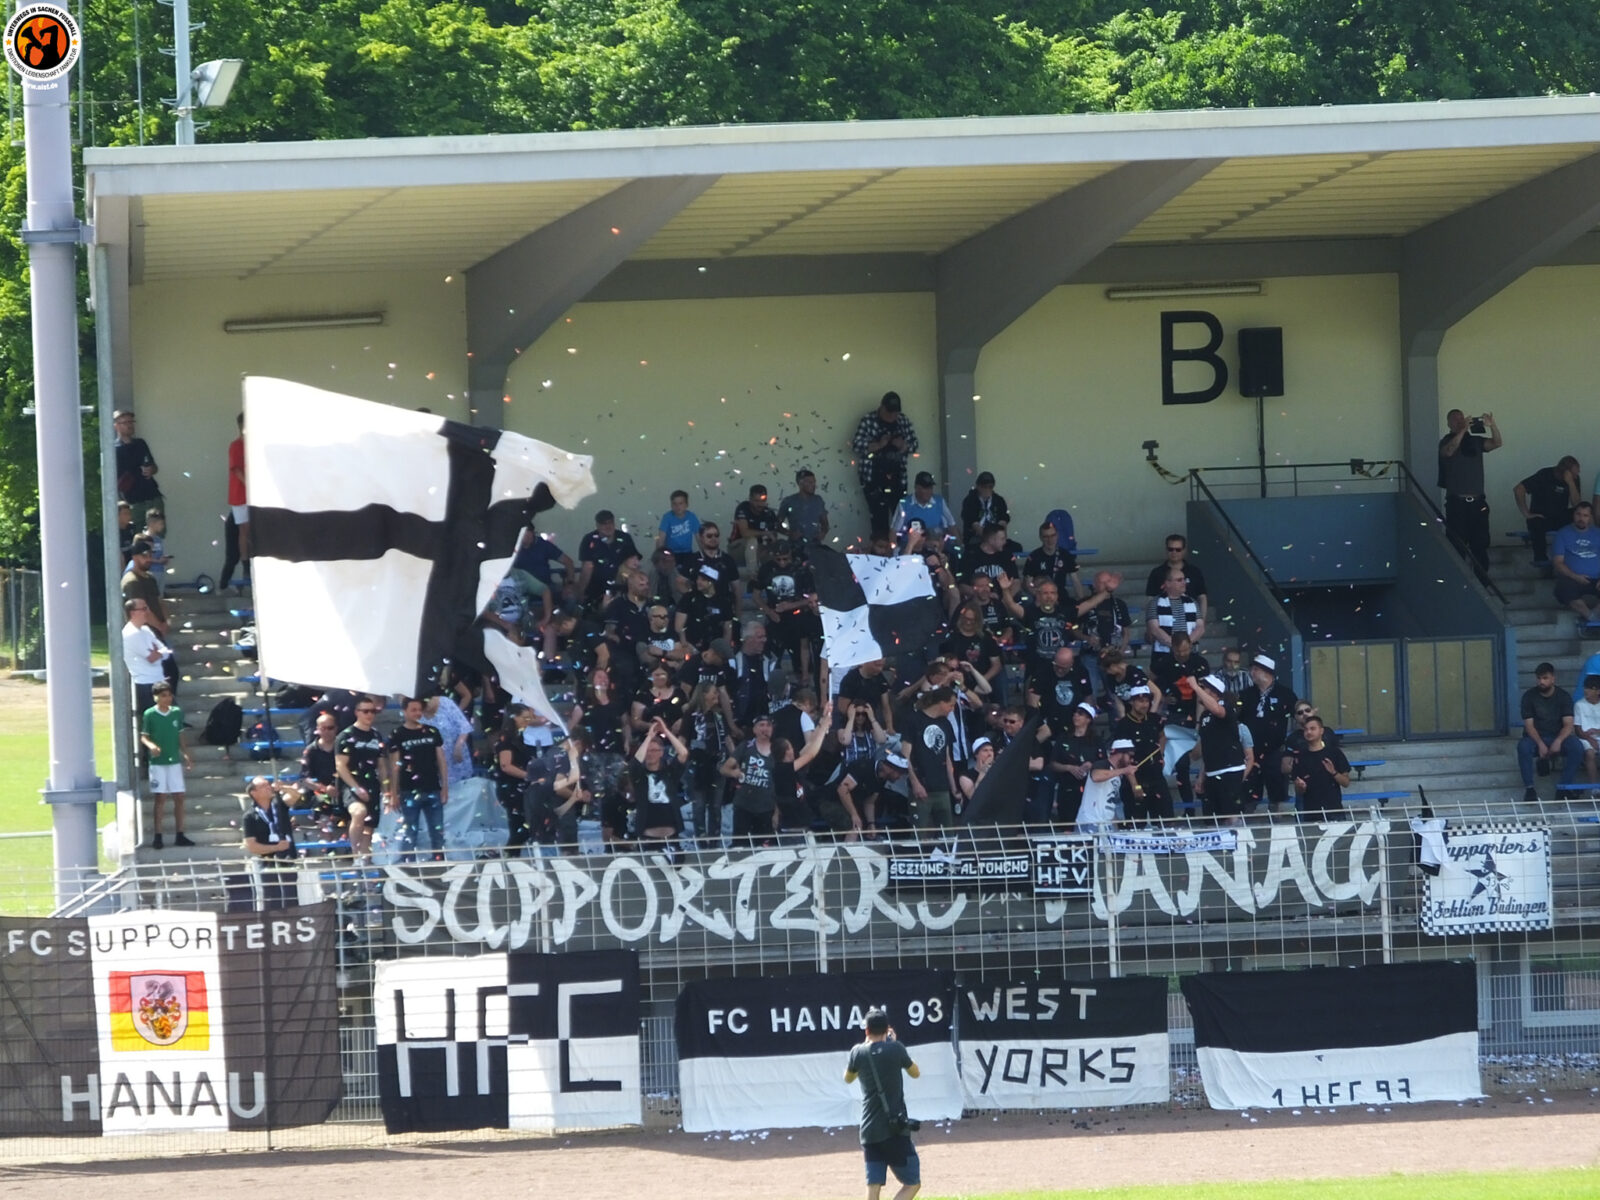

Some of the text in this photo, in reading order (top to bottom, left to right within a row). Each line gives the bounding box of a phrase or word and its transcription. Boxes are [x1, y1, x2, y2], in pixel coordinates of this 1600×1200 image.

[1160, 310, 1228, 405] B
[749, 756, 765, 767] DO
[1037, 844, 1087, 863] FCK
[1447, 836, 1541, 861] upporters
[890, 862, 944, 875] SEZIONE
[1038, 866, 1088, 885] HFV
[1433, 899, 1486, 919] Sektion
[8, 917, 316, 956] FC SUPPORTERS
[708, 997, 943, 1035] FC HANA 93
[967, 987, 1097, 1022] WEST
[975, 1045, 1136, 1095] YORKS
[60, 1070, 266, 1122] HANAU
[1271, 1088, 1284, 1106] 1
